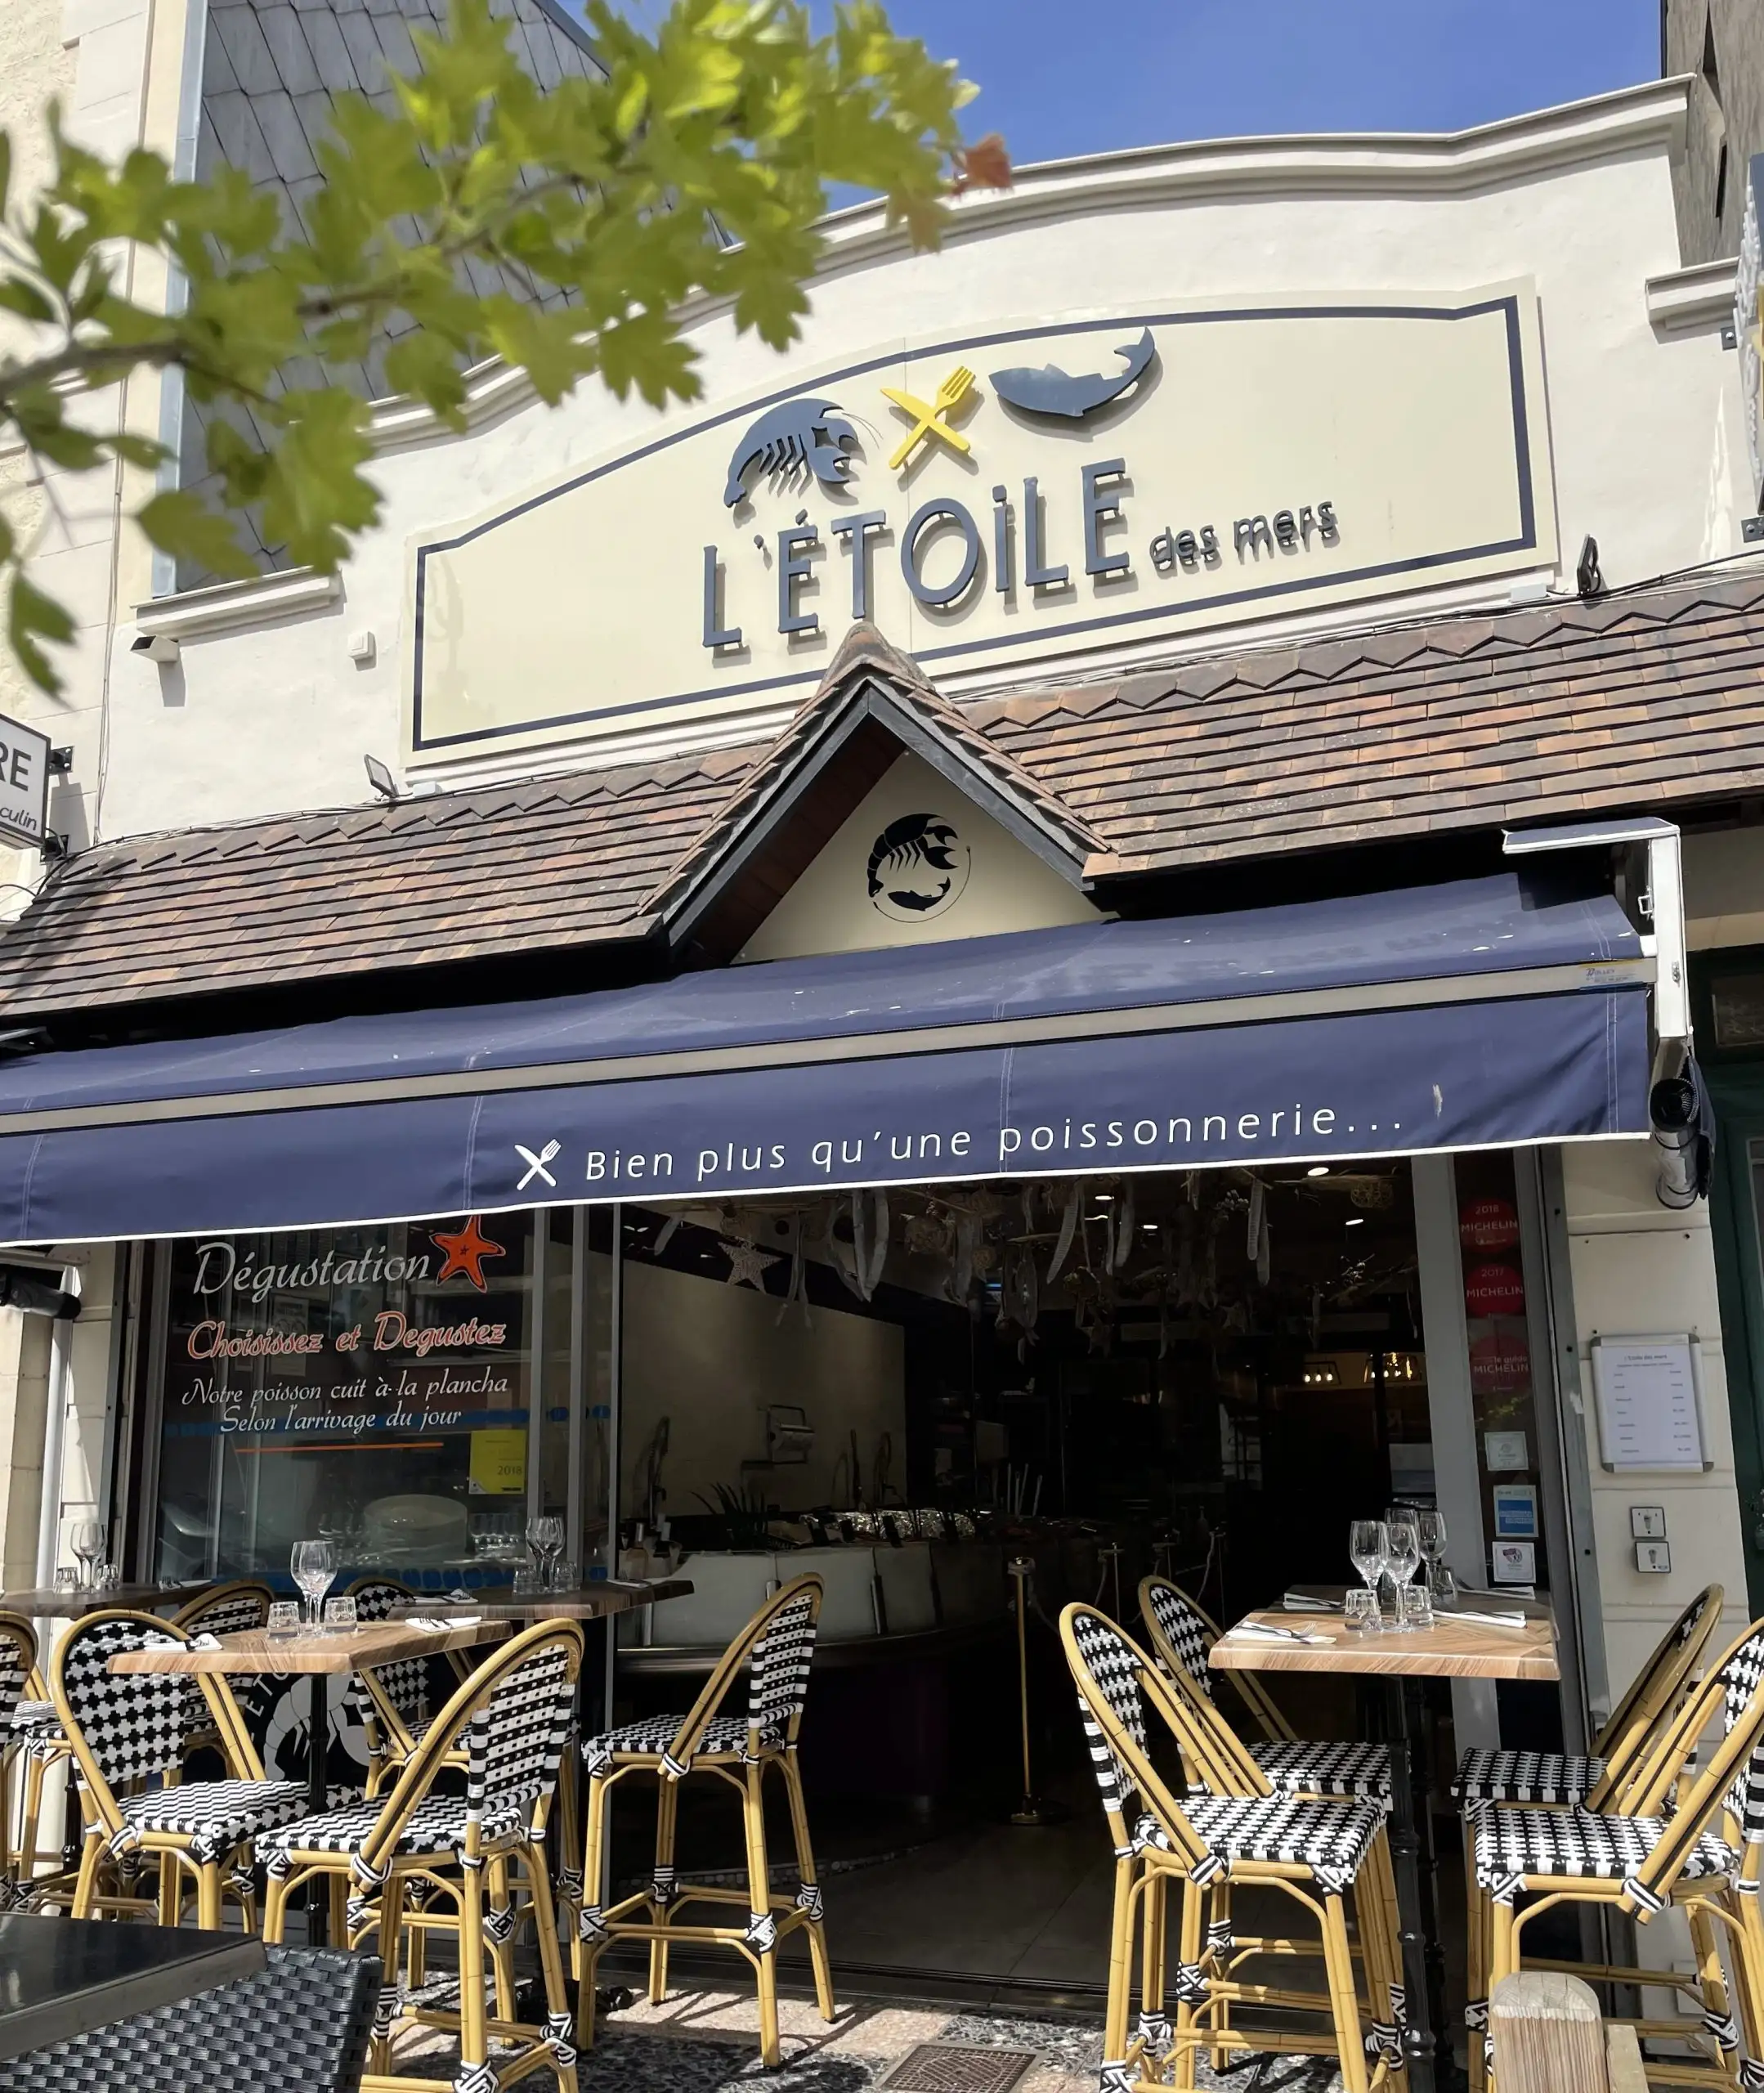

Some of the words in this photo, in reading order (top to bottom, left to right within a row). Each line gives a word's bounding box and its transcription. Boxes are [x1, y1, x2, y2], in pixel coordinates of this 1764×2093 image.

[1150, 524, 1216, 566] des
[1233, 500, 1337, 551] mers
[585, 1150, 673, 1181] Bien
[697, 1142, 785, 1181] plus
[1461, 1219, 1518, 1233] MICHELIN
[193, 1241, 430, 1304] Dégustation
[1466, 1286, 1524, 1297] MICHELIN
[187, 1320, 324, 1360] Choisissez
[335, 1323, 362, 1351] et
[373, 1310, 508, 1358] Degustez
[1474, 1363, 1529, 1374] MICHELIN
[181, 1377, 244, 1405] Notre
[250, 1381, 322, 1411] poisson
[330, 1378, 367, 1399] cuit
[426, 1366, 508, 1402] plancha
[220, 1406, 276, 1433] Selon
[386, 1401, 412, 1427] du
[419, 1410, 462, 1432] jour
[497, 1465, 522, 1475] 2018
